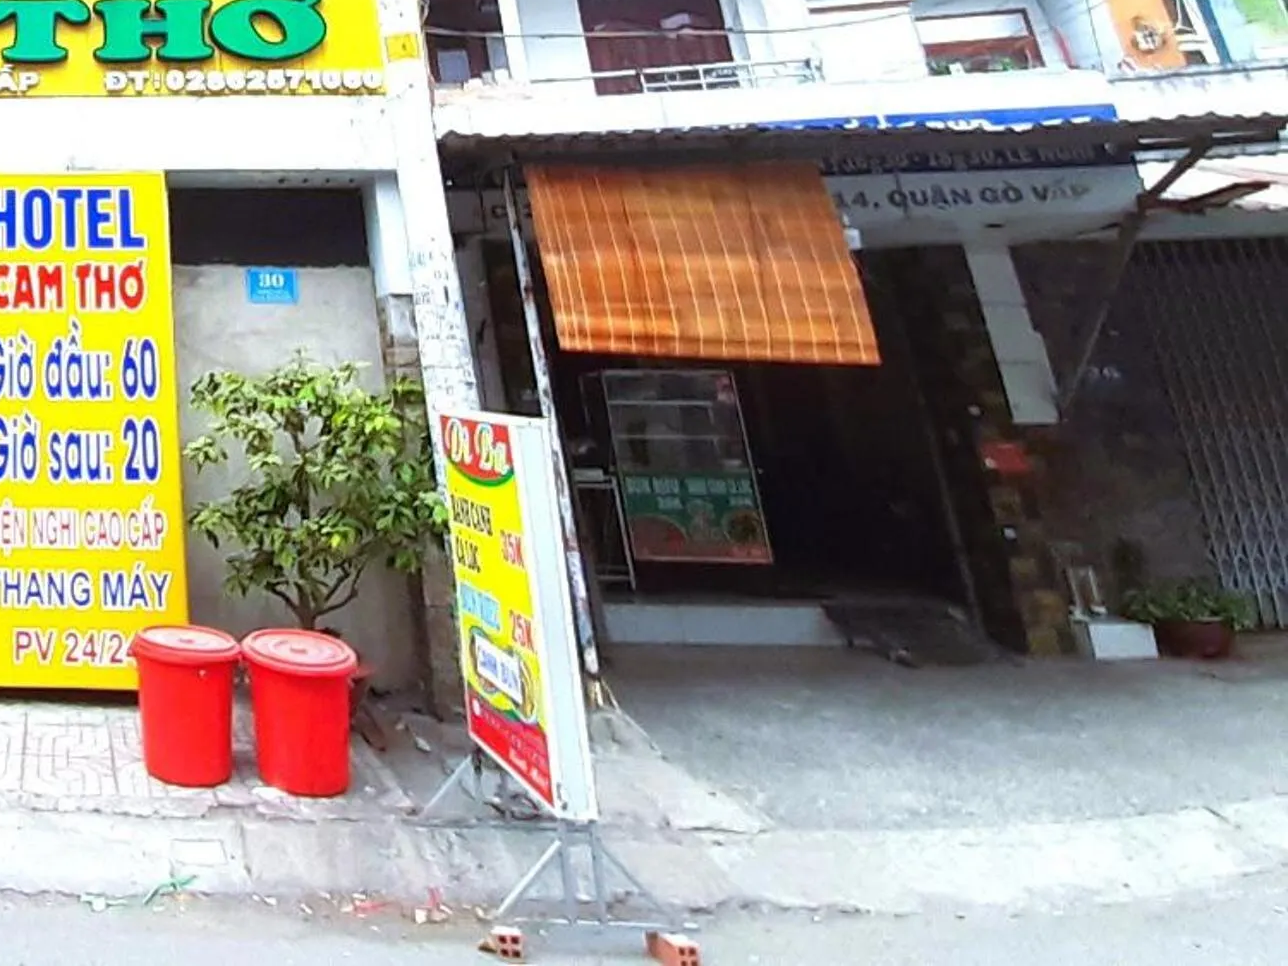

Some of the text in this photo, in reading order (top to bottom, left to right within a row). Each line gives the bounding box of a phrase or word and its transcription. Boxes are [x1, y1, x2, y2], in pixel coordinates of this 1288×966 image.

[74, 260, 145, 310] THƠ
[122, 338, 158, 398] 60
[48, 430, 113, 481] sau:
[122, 418, 160, 481] 20
[32, 511, 77, 546] NGHI
[83, 511, 122, 546] CAO
[127, 497, 165, 546] CẤP
[101, 563, 172, 609] MÁY
[14, 630, 55, 663] PV
